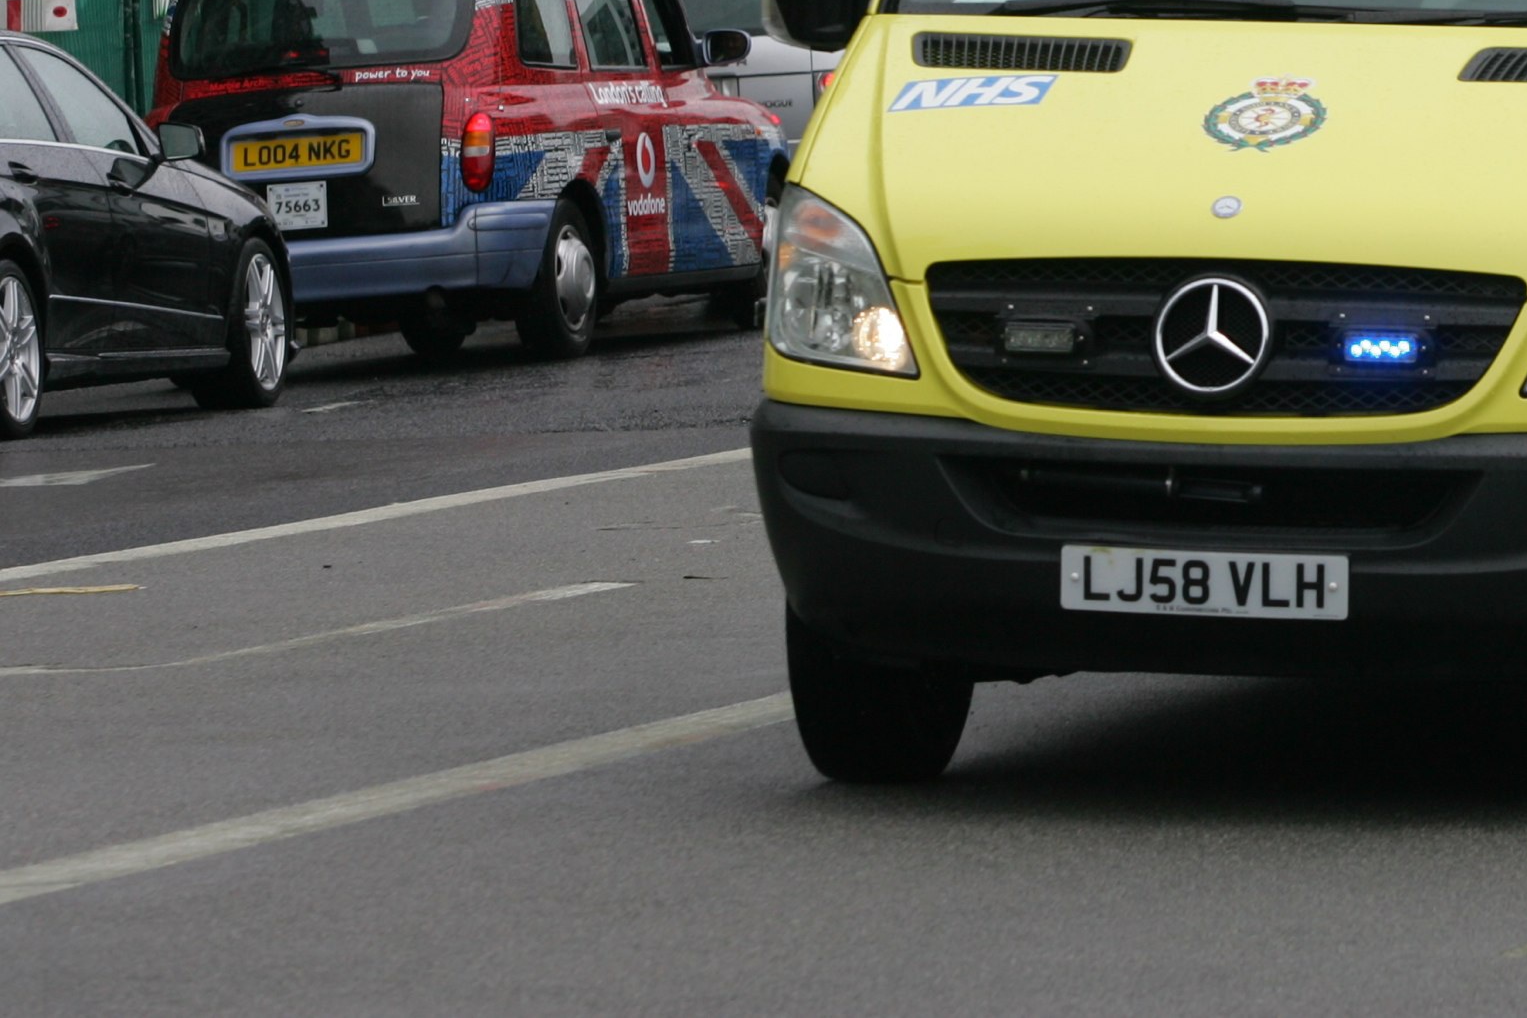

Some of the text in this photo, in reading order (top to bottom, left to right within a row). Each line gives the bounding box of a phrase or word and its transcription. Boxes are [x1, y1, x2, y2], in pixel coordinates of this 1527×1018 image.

[355, 67, 430, 82] power to you
[589, 81, 668, 108] London's calling
[890, 76, 1055, 111] NHS
[308, 139, 351, 161] NKG
[275, 198, 320, 214] 75663
[627, 192, 665, 217] vodafone
[1083, 554, 1326, 609] LJ58 VLH
